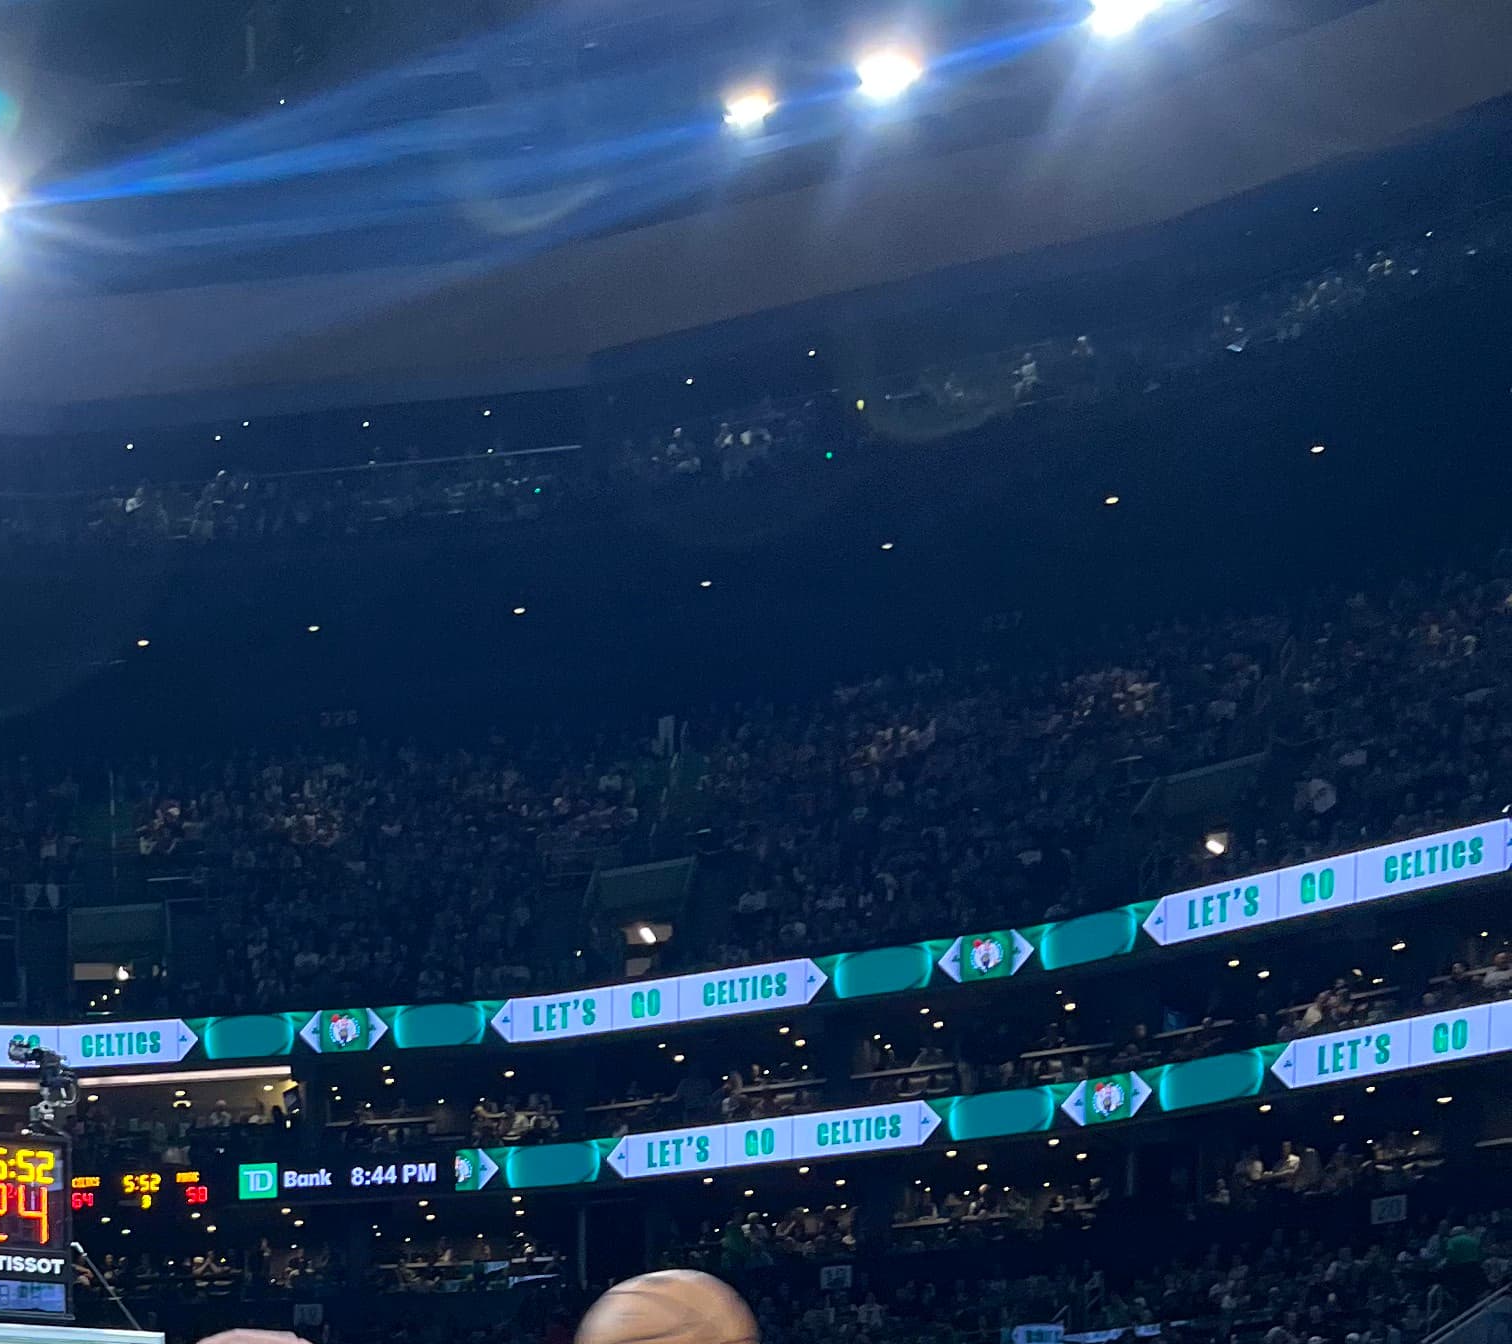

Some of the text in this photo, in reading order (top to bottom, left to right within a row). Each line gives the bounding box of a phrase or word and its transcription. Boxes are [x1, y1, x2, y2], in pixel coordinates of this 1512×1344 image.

[1187, 836, 1483, 930] LET'S GO CELTICS
[532, 972, 787, 1034] LET'S GO CELTICS
[81, 1030, 161, 1059] CELTICS
[1317, 1018, 1468, 1075] LET'S GO
[646, 1114, 902, 1169] LET'S GO CELTICS
[122, 1173, 162, 1193] 5:52
[243, 1162, 437, 1192] TD Bank 8:44 PM
